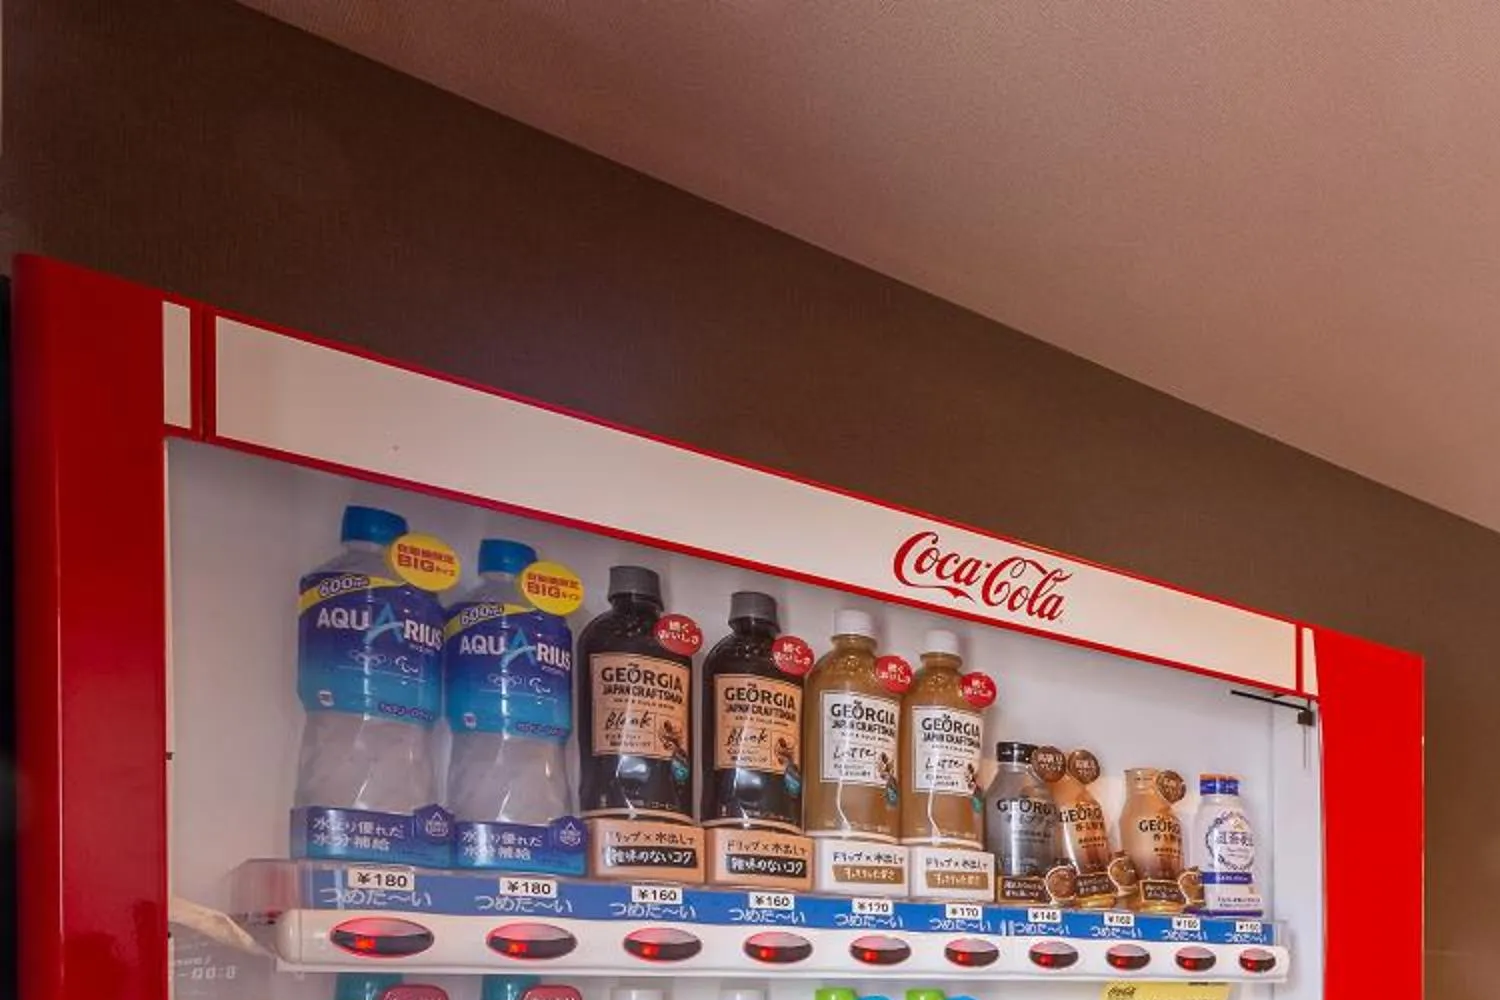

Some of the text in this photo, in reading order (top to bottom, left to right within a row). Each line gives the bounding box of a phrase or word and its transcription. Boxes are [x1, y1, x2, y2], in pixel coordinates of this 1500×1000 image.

[316, 603, 443, 651] AQUARIUS
[459, 628, 572, 672] AQUARIUS
[356, 871, 408, 889] ¥180
[506, 880, 552, 895] ¥180
[638, 888, 677, 901] ¥160
[755, 894, 790, 907] ¥160
